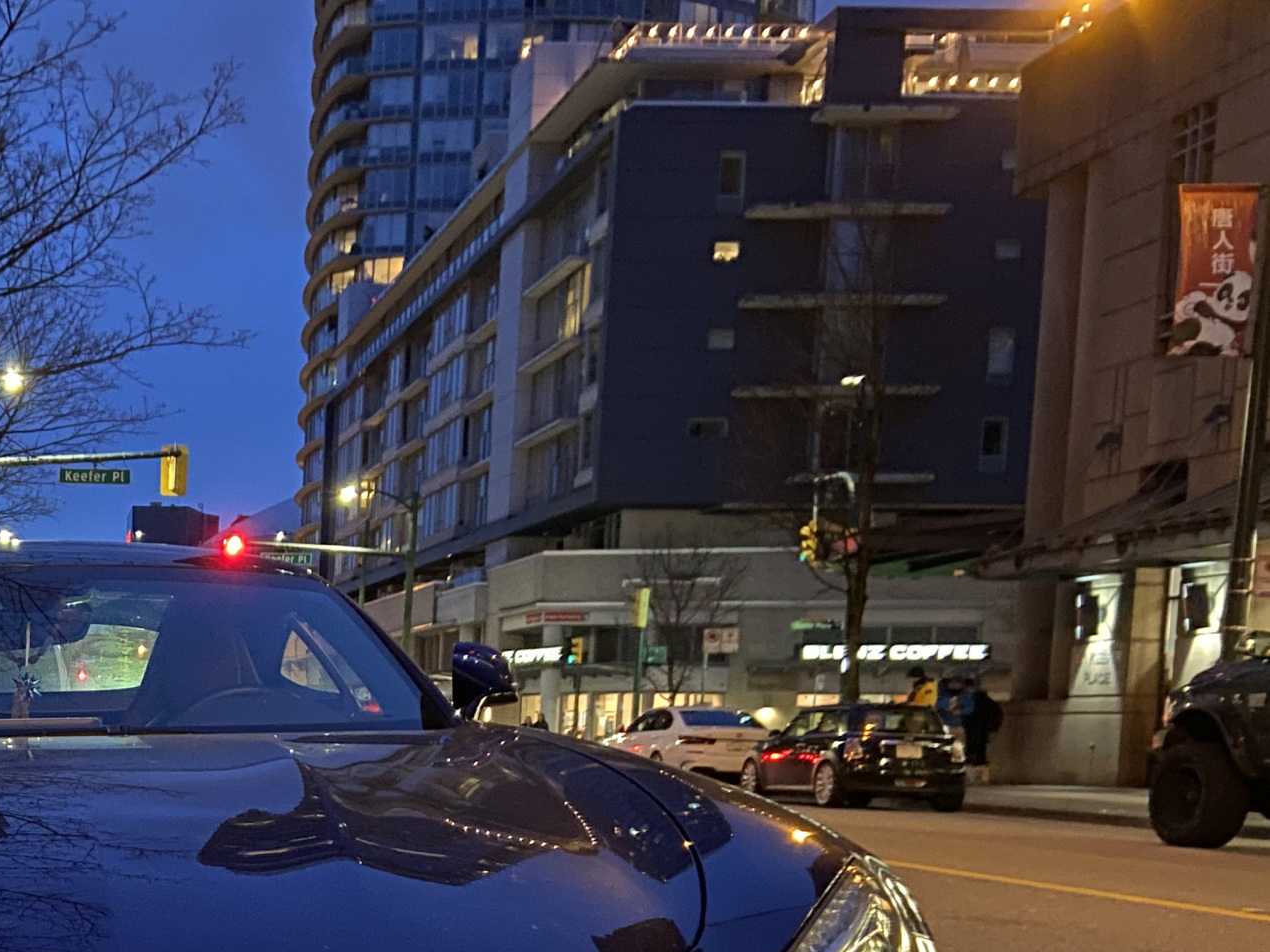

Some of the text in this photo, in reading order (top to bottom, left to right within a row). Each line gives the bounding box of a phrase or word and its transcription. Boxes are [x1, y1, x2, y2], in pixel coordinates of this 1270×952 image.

[1210, 206, 1235, 275] 唐人街
[64, 469, 125, 483] Keefer Pl
[888, 644, 990, 661] COFFEE
